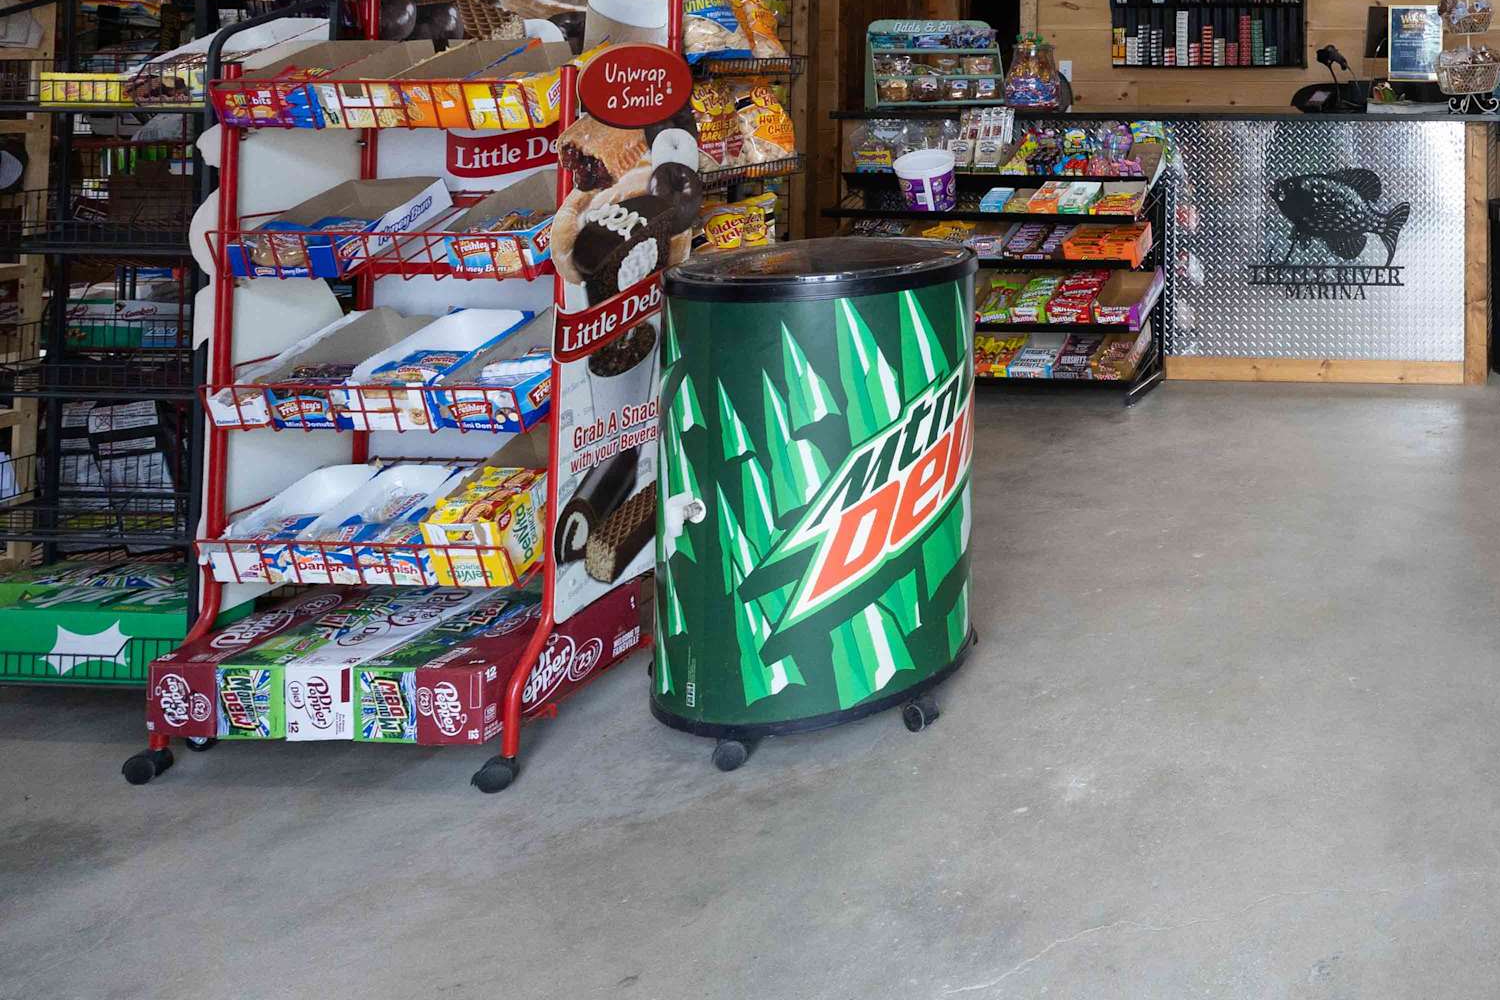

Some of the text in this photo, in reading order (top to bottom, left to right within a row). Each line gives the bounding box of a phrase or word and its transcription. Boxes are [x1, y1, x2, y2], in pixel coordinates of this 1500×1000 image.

[893, 22, 920, 33] Odds
[606, 63, 667, 84] Unwrap
[252, 96, 272, 106] bits
[608, 80, 663, 108] a Smile
[455, 142, 521, 170] Little
[378, 195, 433, 247] Honey Buns
[456, 264, 483, 274] Hney
[1337, 266, 1400, 285] RIVER
[1285, 285, 1366, 300] MARINA
[561, 312, 618, 353] Little
[573, 417, 604, 450] Grab
[607, 411, 618, 434] A
[570, 453, 592, 474] with
[593, 440, 618, 467] your
[806, 373, 962, 532] Mtn
[513, 504, 535, 563] belVita
[299, 562, 345, 573] Dansh
[522, 646, 570, 703] epper
[225, 691, 249, 727] DEW
[307, 680, 329, 726] Pepper
[379, 681, 406, 718] DEW
[434, 686, 458, 732] Pepper
